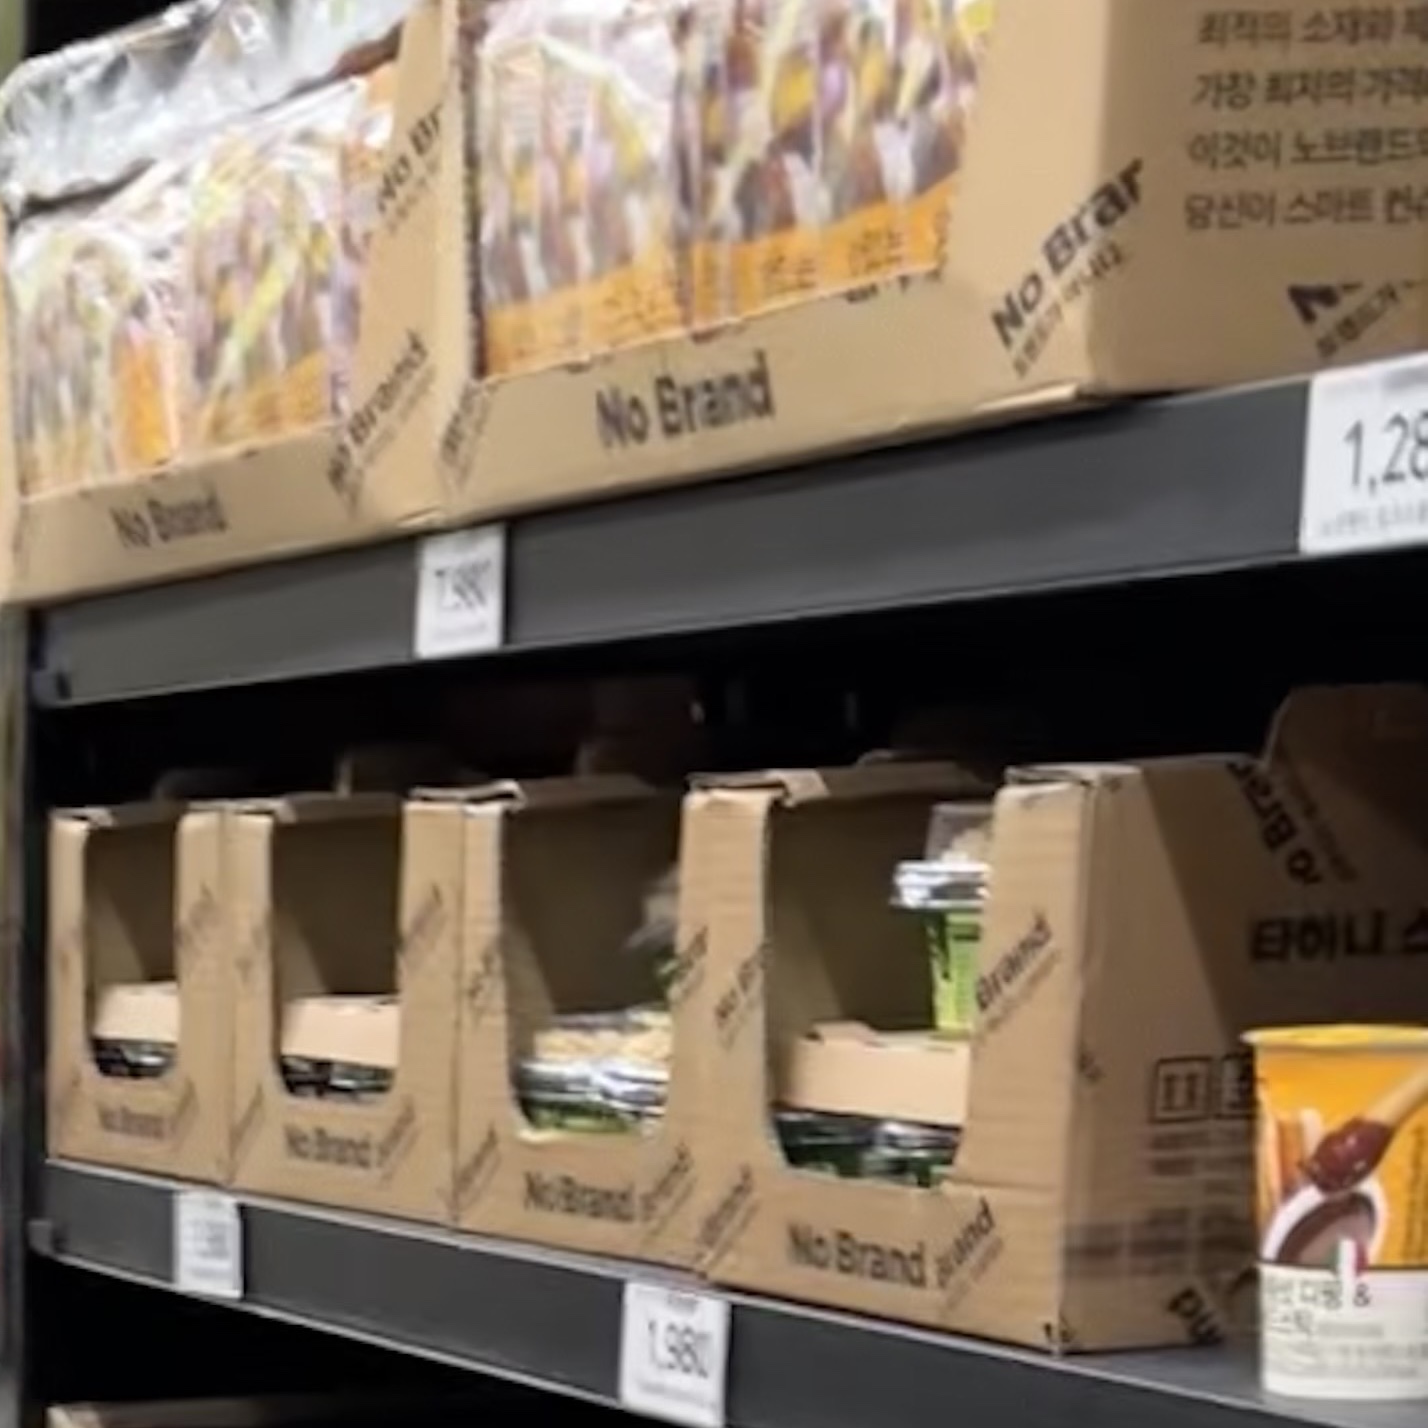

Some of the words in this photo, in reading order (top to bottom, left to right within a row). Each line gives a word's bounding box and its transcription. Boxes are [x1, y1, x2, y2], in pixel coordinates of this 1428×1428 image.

[1188, 130, 1280, 171] 이것이
[991, 270, 1043, 350] No
[596, 390, 646, 450] No
[656, 348, 775, 440] Brand
[1249, 909, 1385, 963] 타이니
[834, 1228, 927, 1289] Brand
